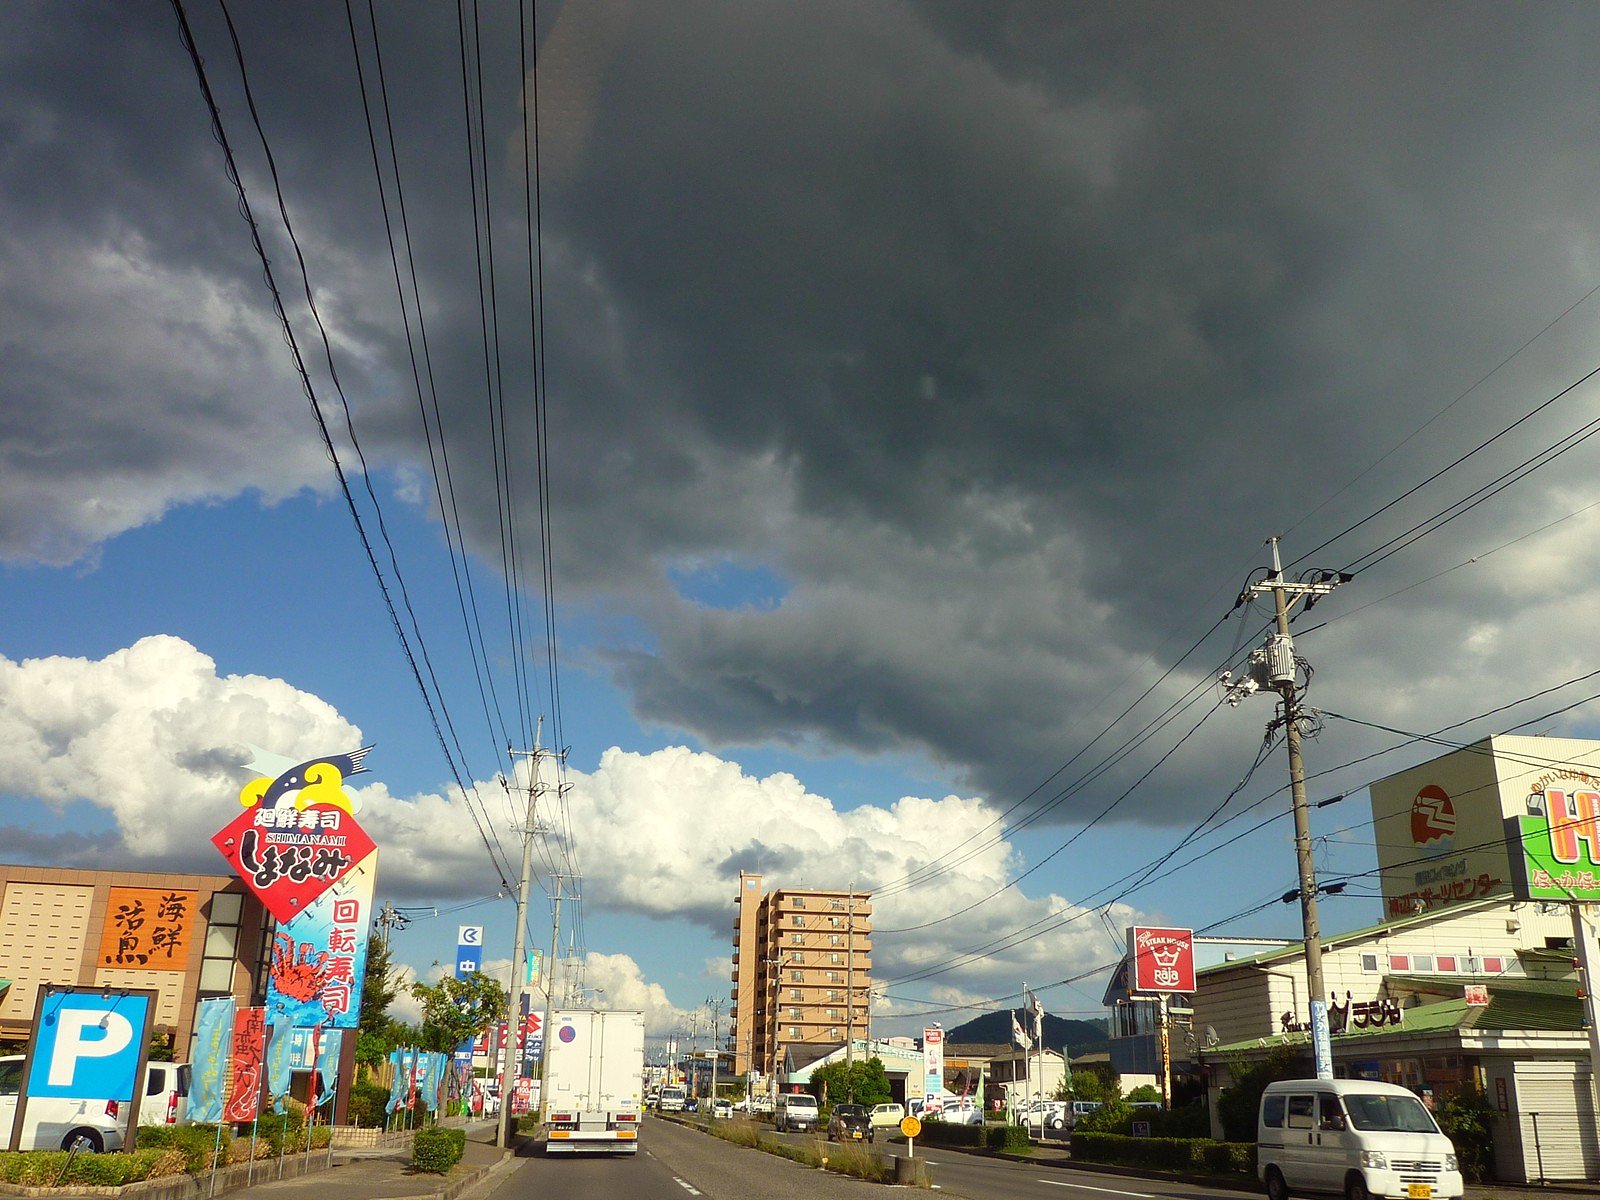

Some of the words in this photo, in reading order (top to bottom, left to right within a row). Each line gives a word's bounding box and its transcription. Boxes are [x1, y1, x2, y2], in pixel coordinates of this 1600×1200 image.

[253, 807, 341, 831] 廻鮮寿司
[265, 832, 346, 846] SHIMANAMI
[240, 829, 349, 889] しまなみ
[106, 900, 149, 965] 活魚
[149, 892, 188, 958] 海鮮
[322, 898, 361, 1014] 回転寿司
[1145, 937, 1166, 947] STEAK
[1167, 937, 1190, 950] HOUSE
[48, 1008, 134, 1087] P
